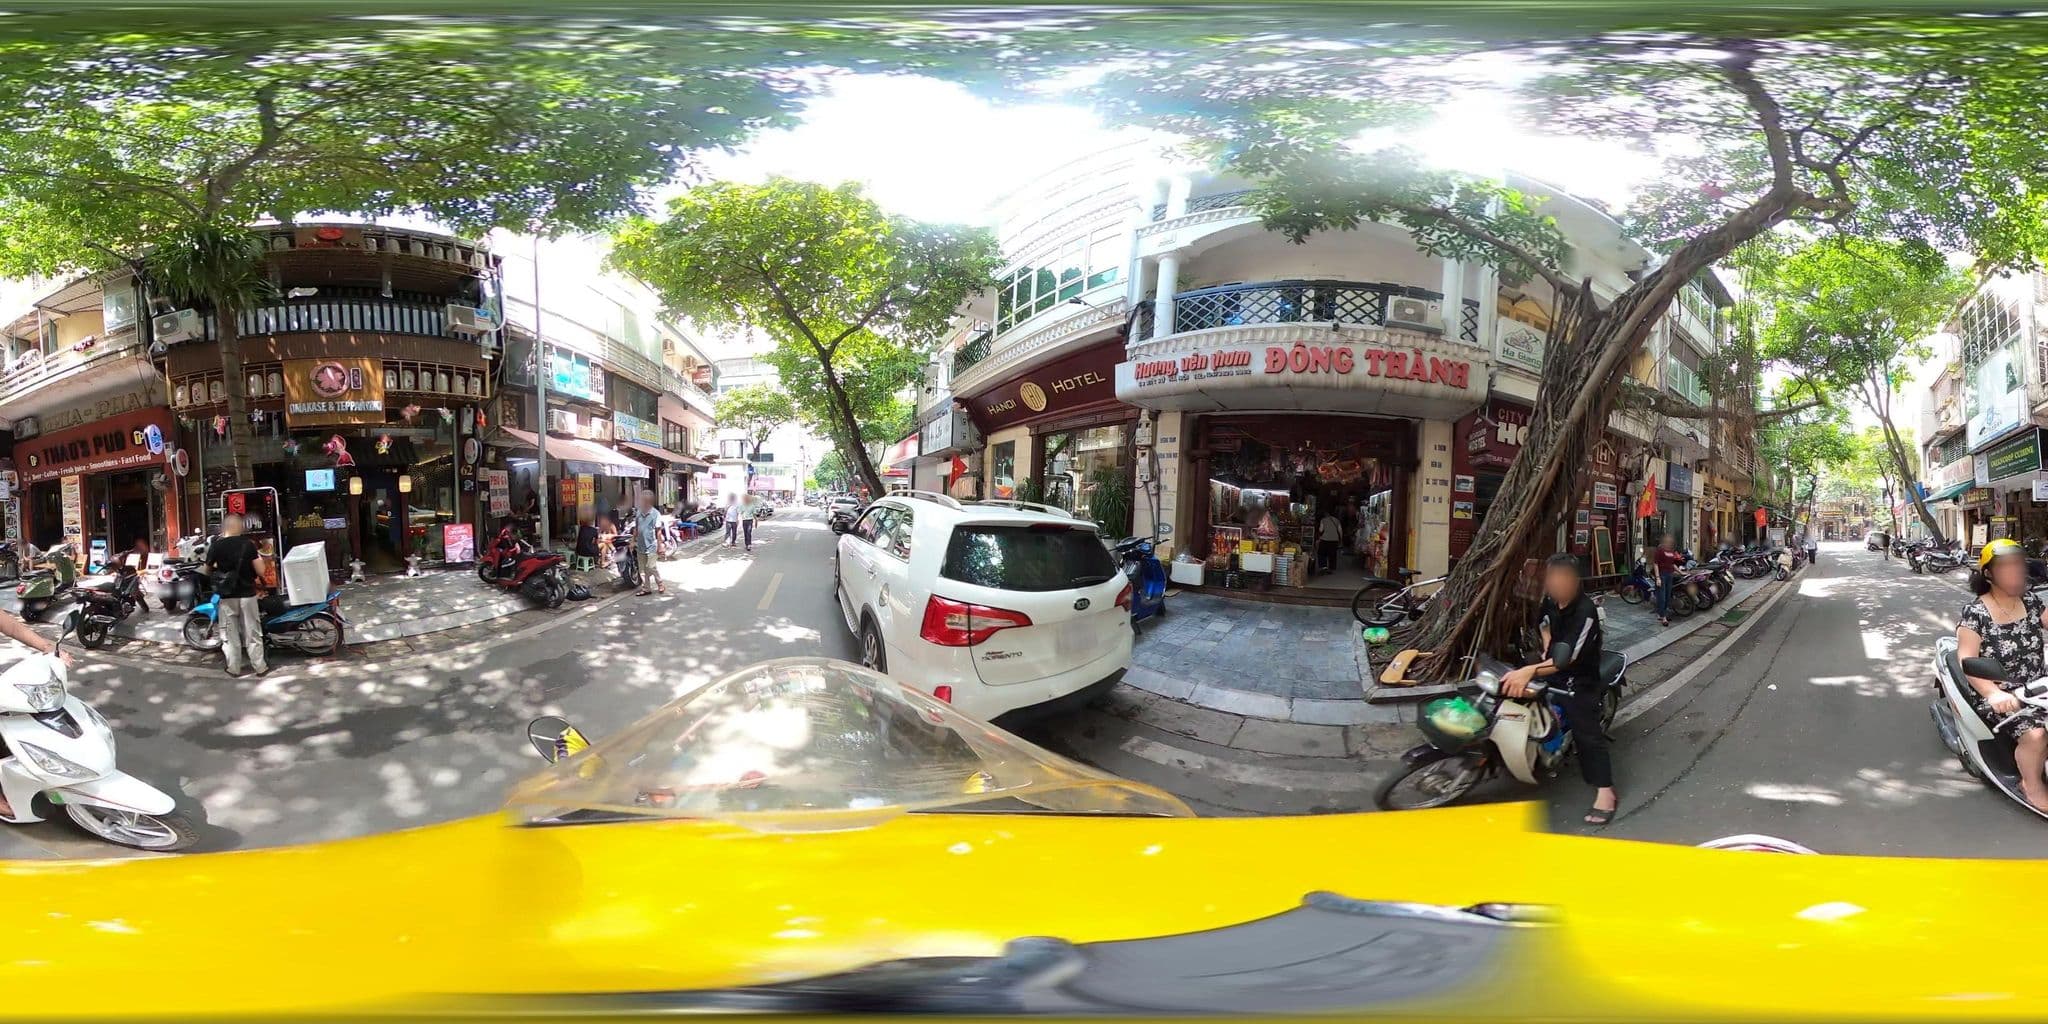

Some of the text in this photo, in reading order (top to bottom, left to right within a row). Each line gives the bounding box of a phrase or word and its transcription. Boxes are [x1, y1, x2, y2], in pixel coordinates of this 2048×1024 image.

[1264, 340, 1471, 389] ĐÔNG THÀNH
[1502, 347, 1542, 369] Ha Giang
[1051, 371, 1106, 394] HOTEL
[289, 401, 327, 414] OMAKASE
[328, 401, 335, 411] &
[1498, 408, 1525, 424] CITY
[120, 455, 134, 465] Fast
[135, 452, 151, 463] Food
[460, 465, 473, 476] 62
